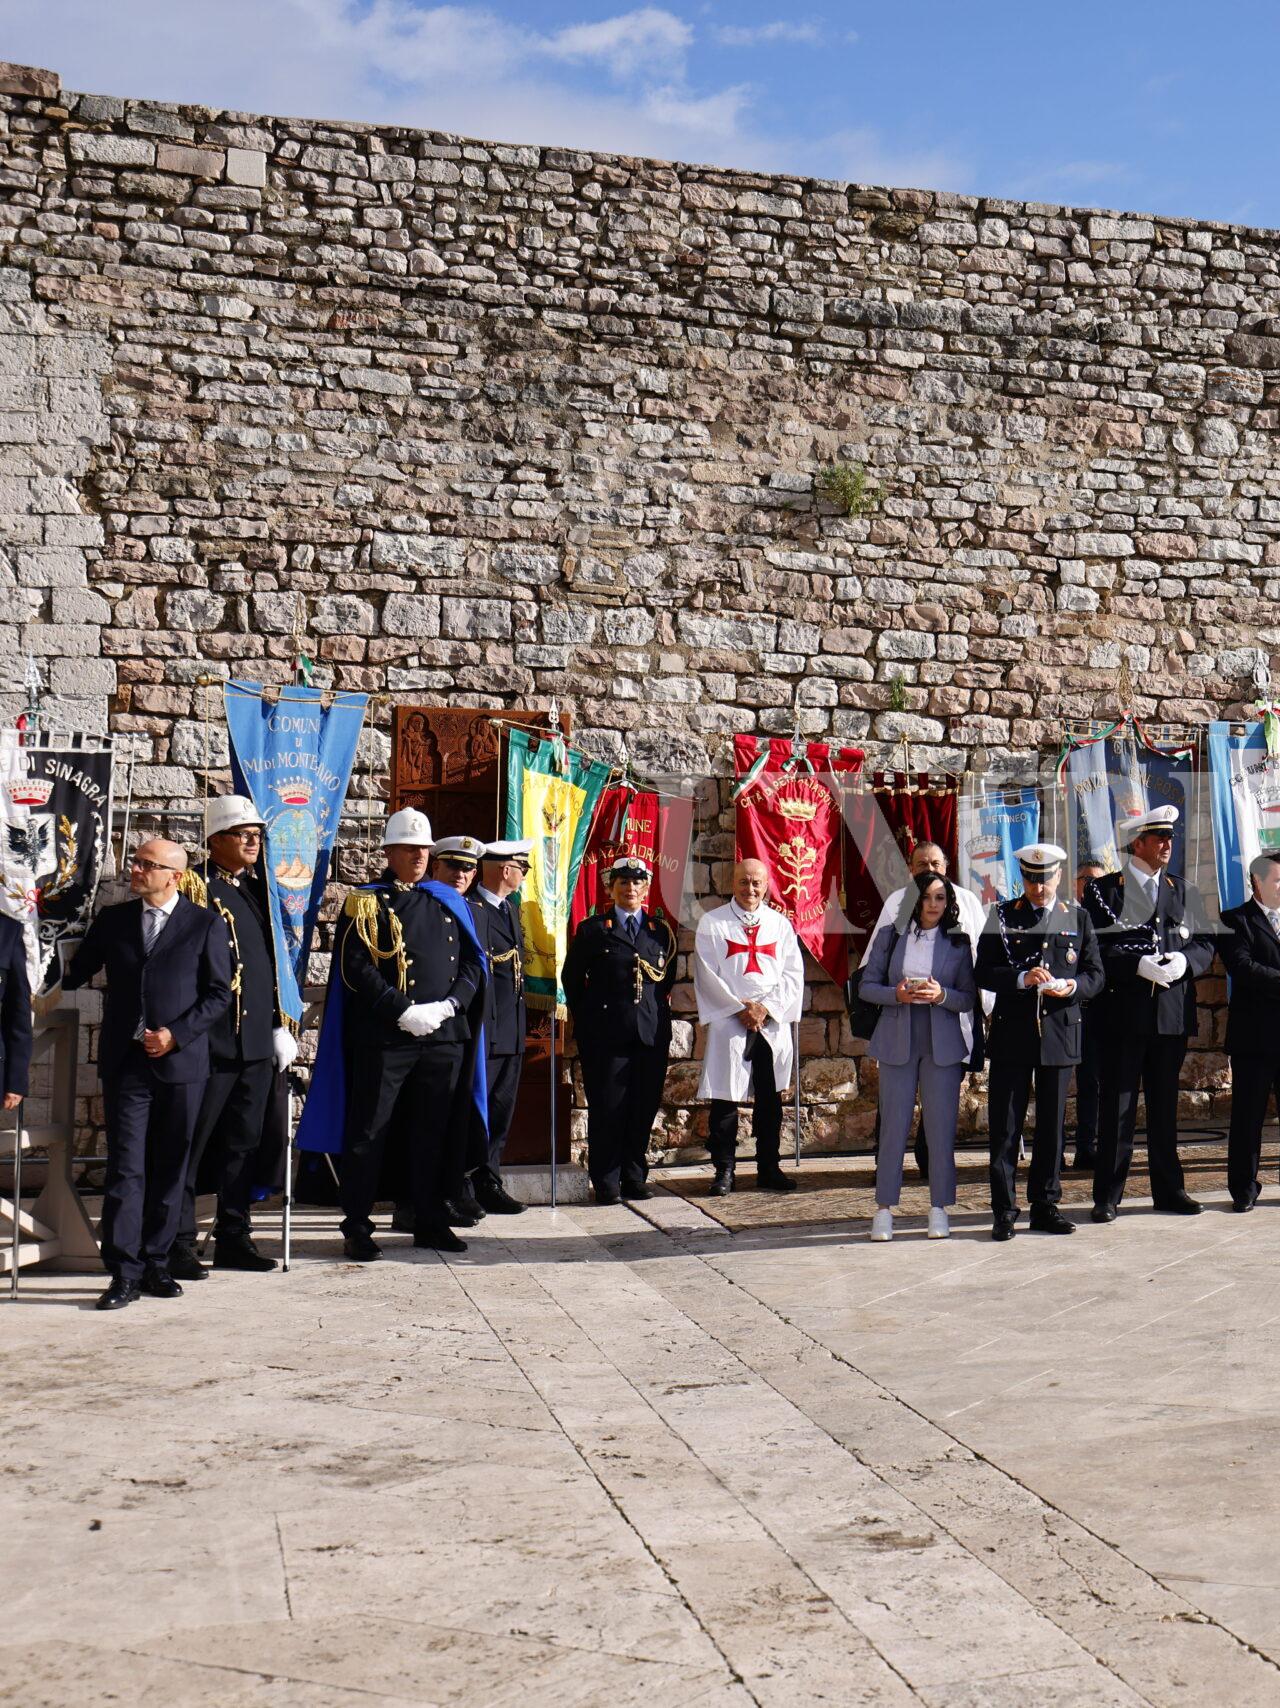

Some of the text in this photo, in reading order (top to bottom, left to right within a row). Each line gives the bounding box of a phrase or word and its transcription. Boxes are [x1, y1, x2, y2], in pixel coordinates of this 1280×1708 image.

[268, 715, 321, 734] COMUN
[44, 758, 108, 808] SINAGRA
[631, 843, 679, 873] ADRIANO
